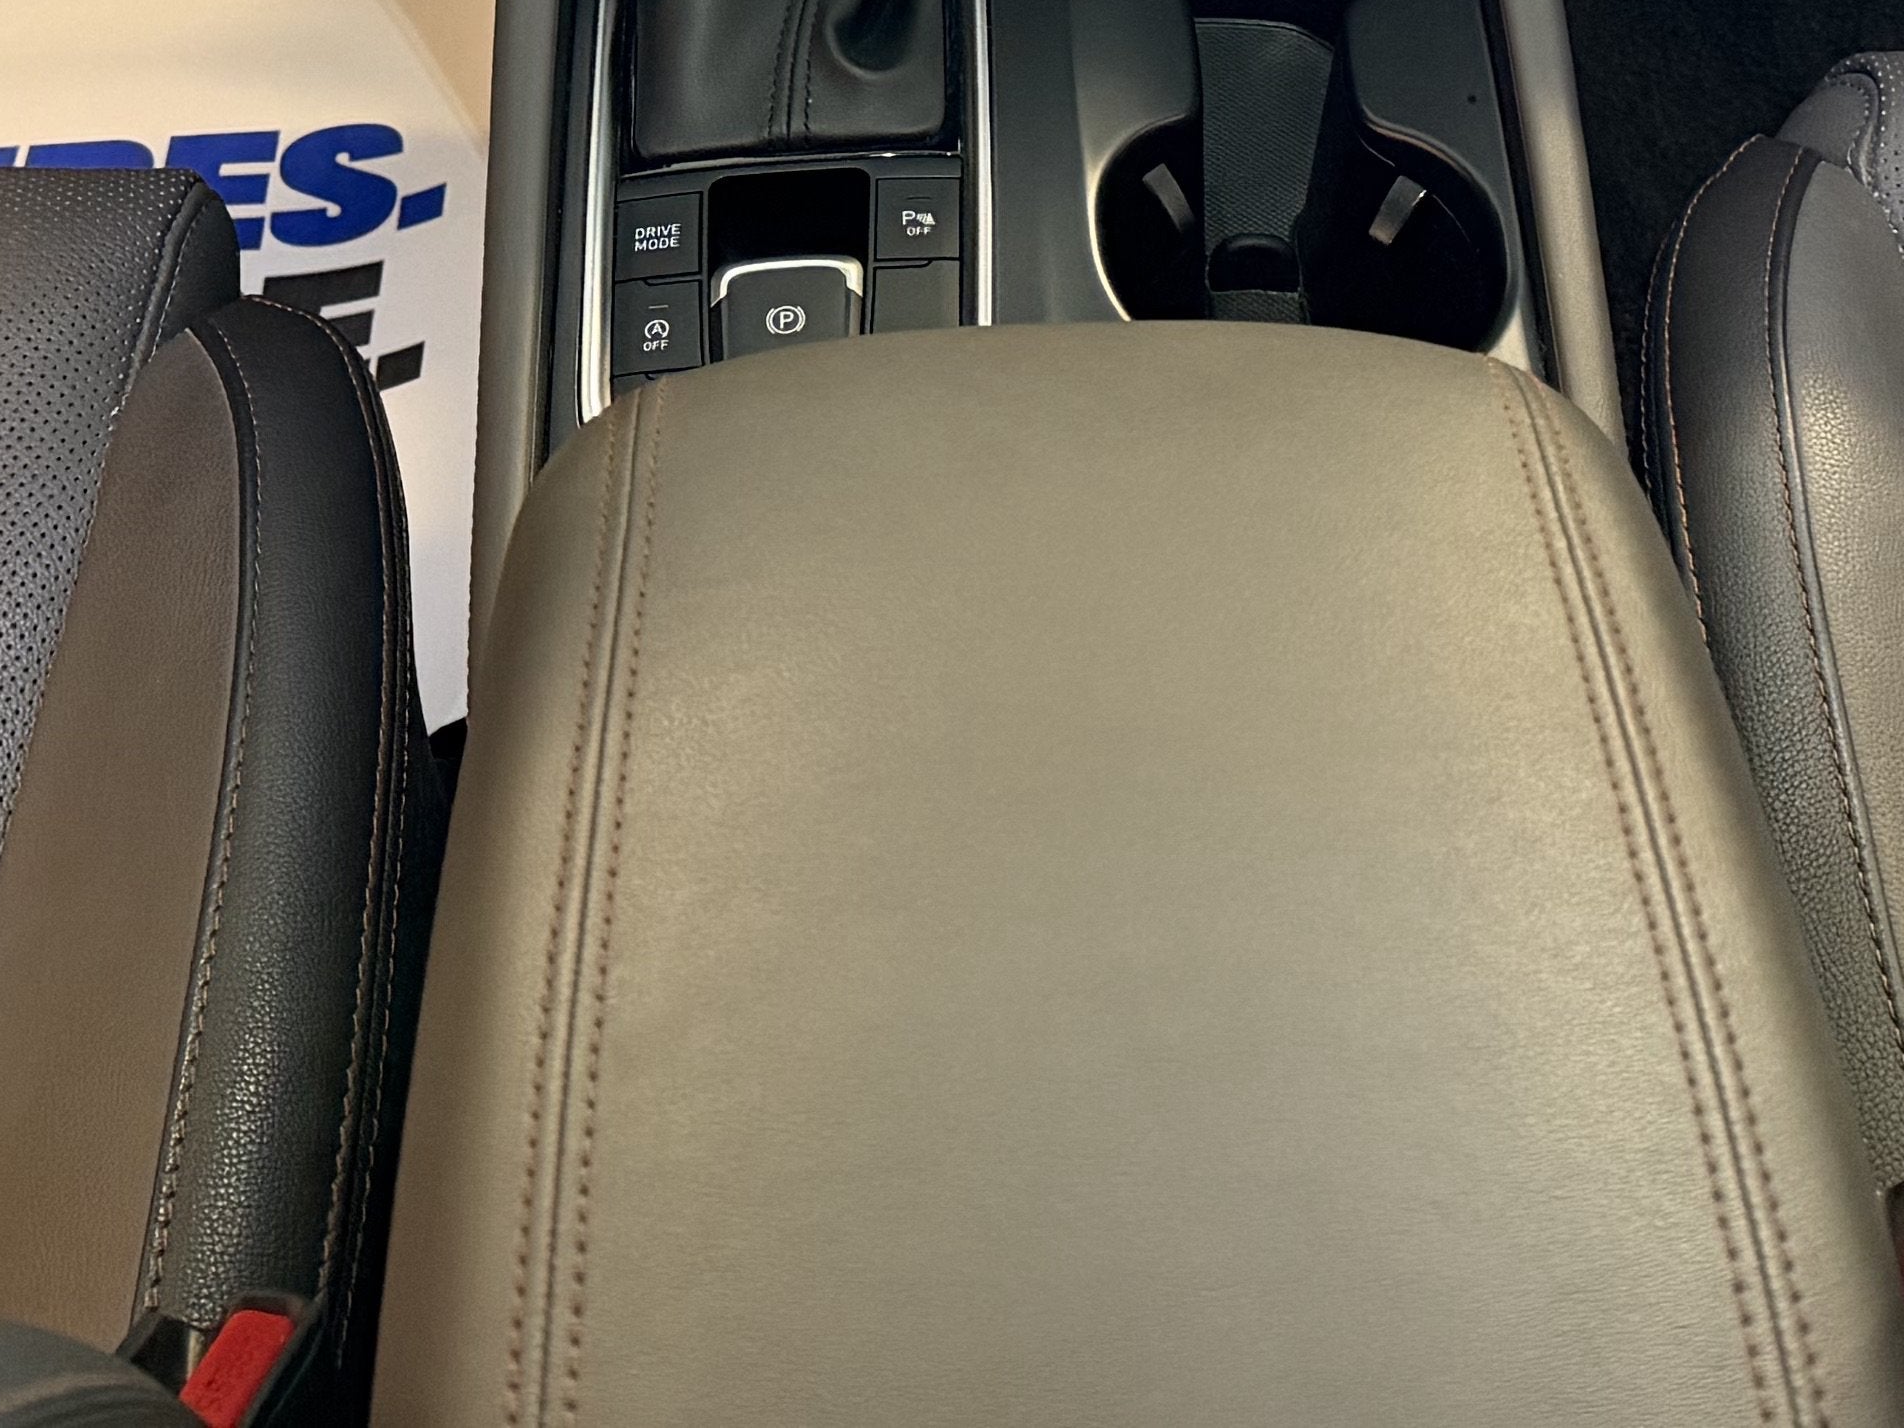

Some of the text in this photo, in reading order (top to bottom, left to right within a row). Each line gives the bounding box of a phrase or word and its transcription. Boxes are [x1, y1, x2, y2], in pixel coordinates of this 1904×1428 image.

[634, 223, 681, 240] DRIVE
[907, 225, 931, 237] OFF
[634, 236, 680, 252] MODE
[643, 339, 669, 352] OFF
